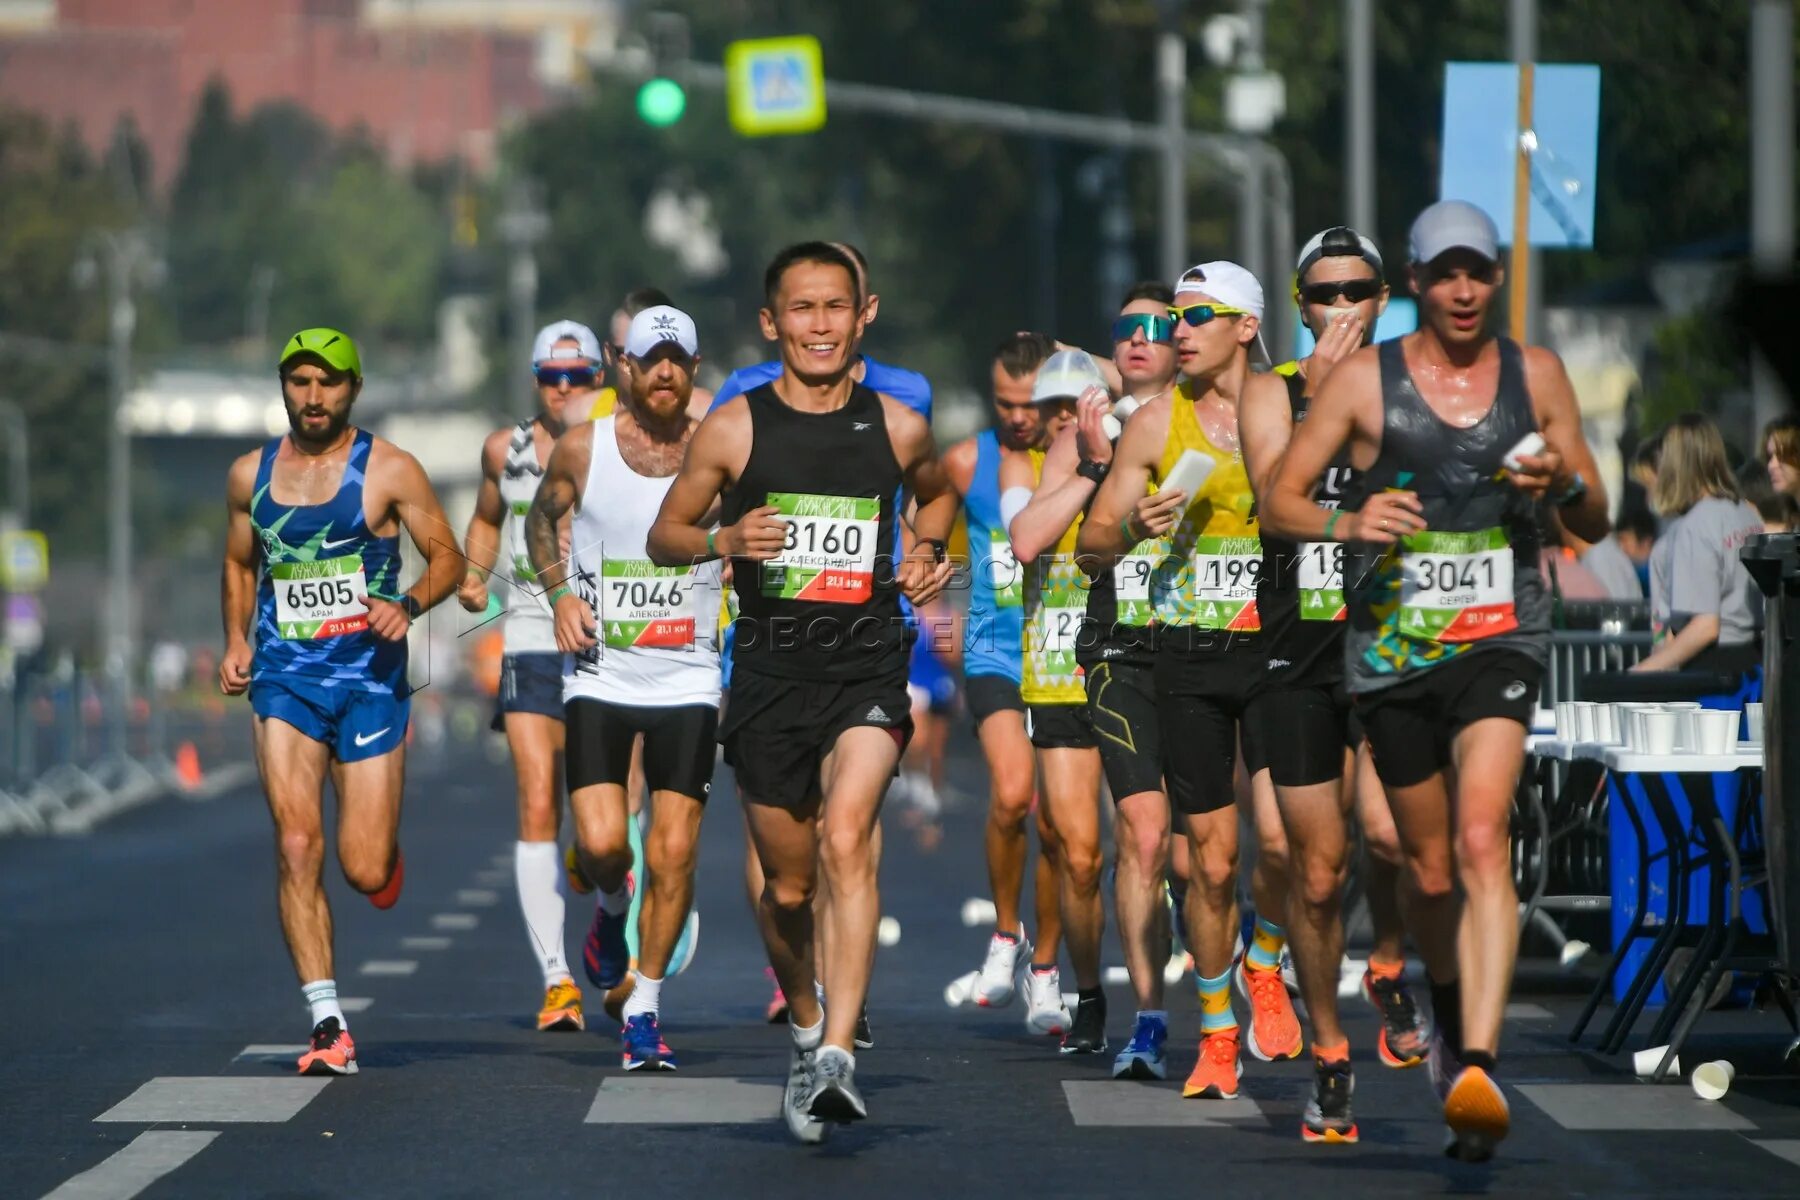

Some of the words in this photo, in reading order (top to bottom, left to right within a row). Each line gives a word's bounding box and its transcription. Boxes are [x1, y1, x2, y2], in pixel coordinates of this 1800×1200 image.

[784, 520, 862, 556] 3160
[789, 555, 851, 568] АЛЕКСАНДР
[1417, 557, 1494, 592] 3041
[287, 579, 354, 609] 6505
[612, 580, 684, 608] 7046
[311, 609, 334, 618] АРАМ
[574, 563, 600, 677] TEEX
[628, 609, 671, 619] АЛЕКСЕЙ
